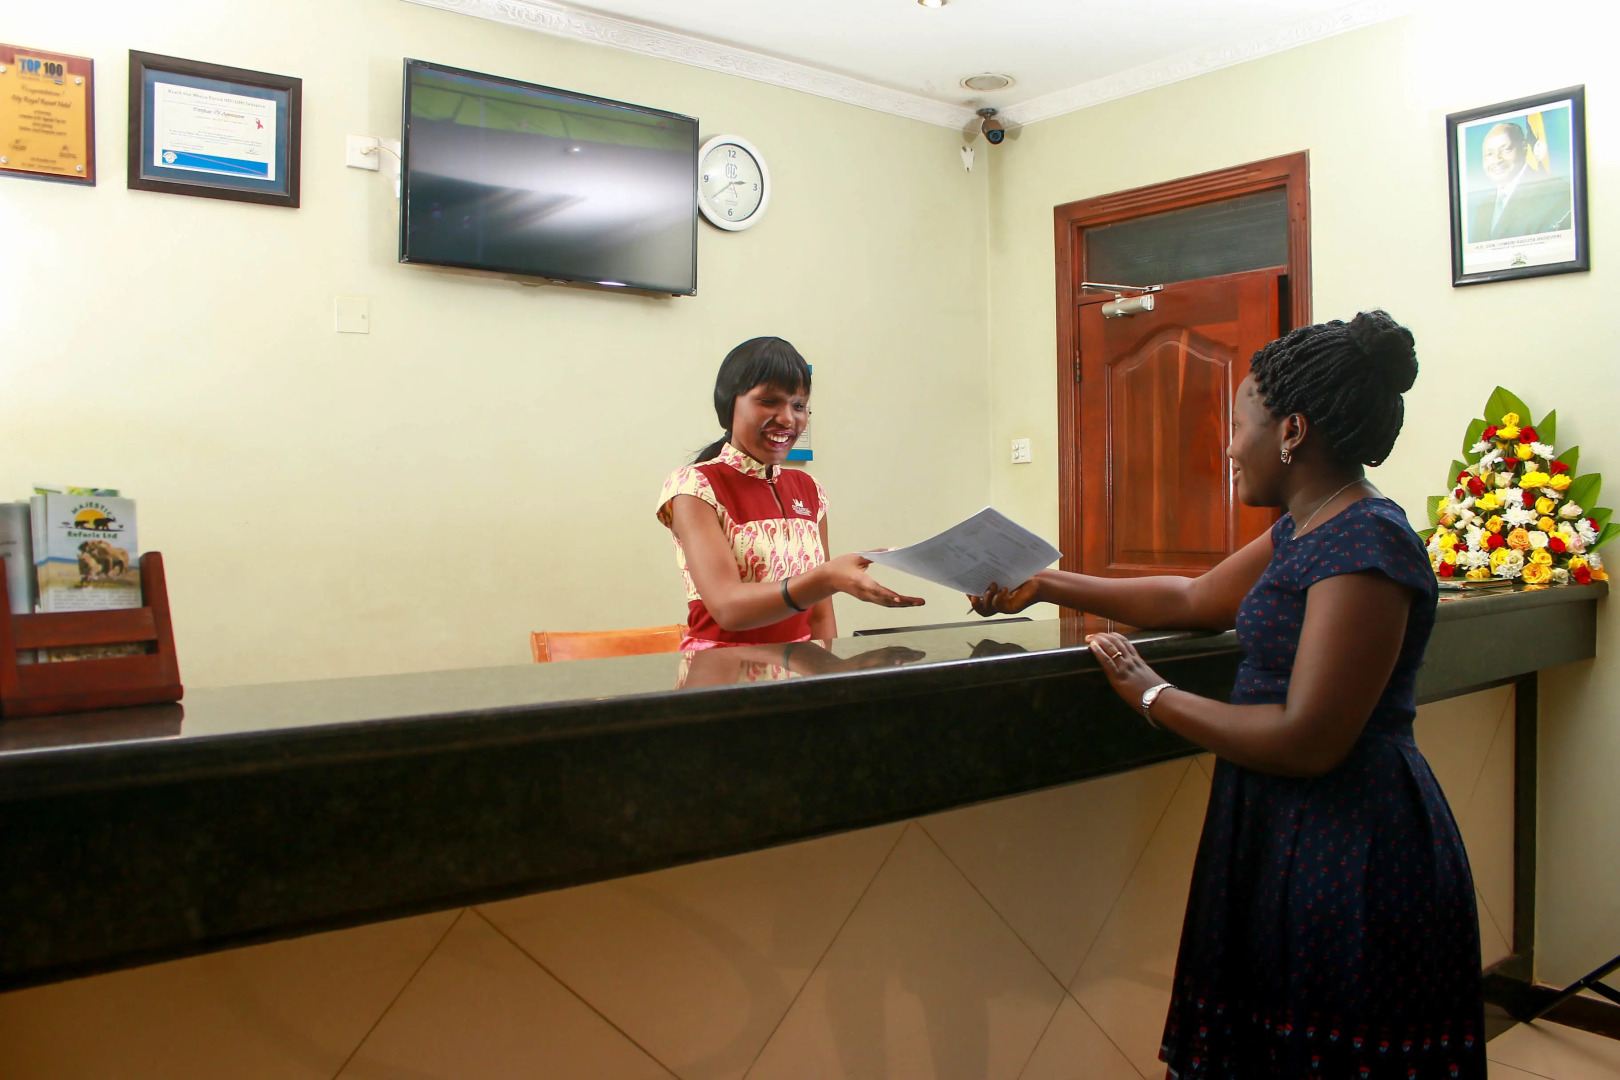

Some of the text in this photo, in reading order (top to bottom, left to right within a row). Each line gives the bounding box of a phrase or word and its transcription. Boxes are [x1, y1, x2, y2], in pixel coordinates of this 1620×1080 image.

[19, 58, 63, 77] TOP 100
[728, 150, 736, 158] 12
[71, 501, 113, 517] MAJESTIC
